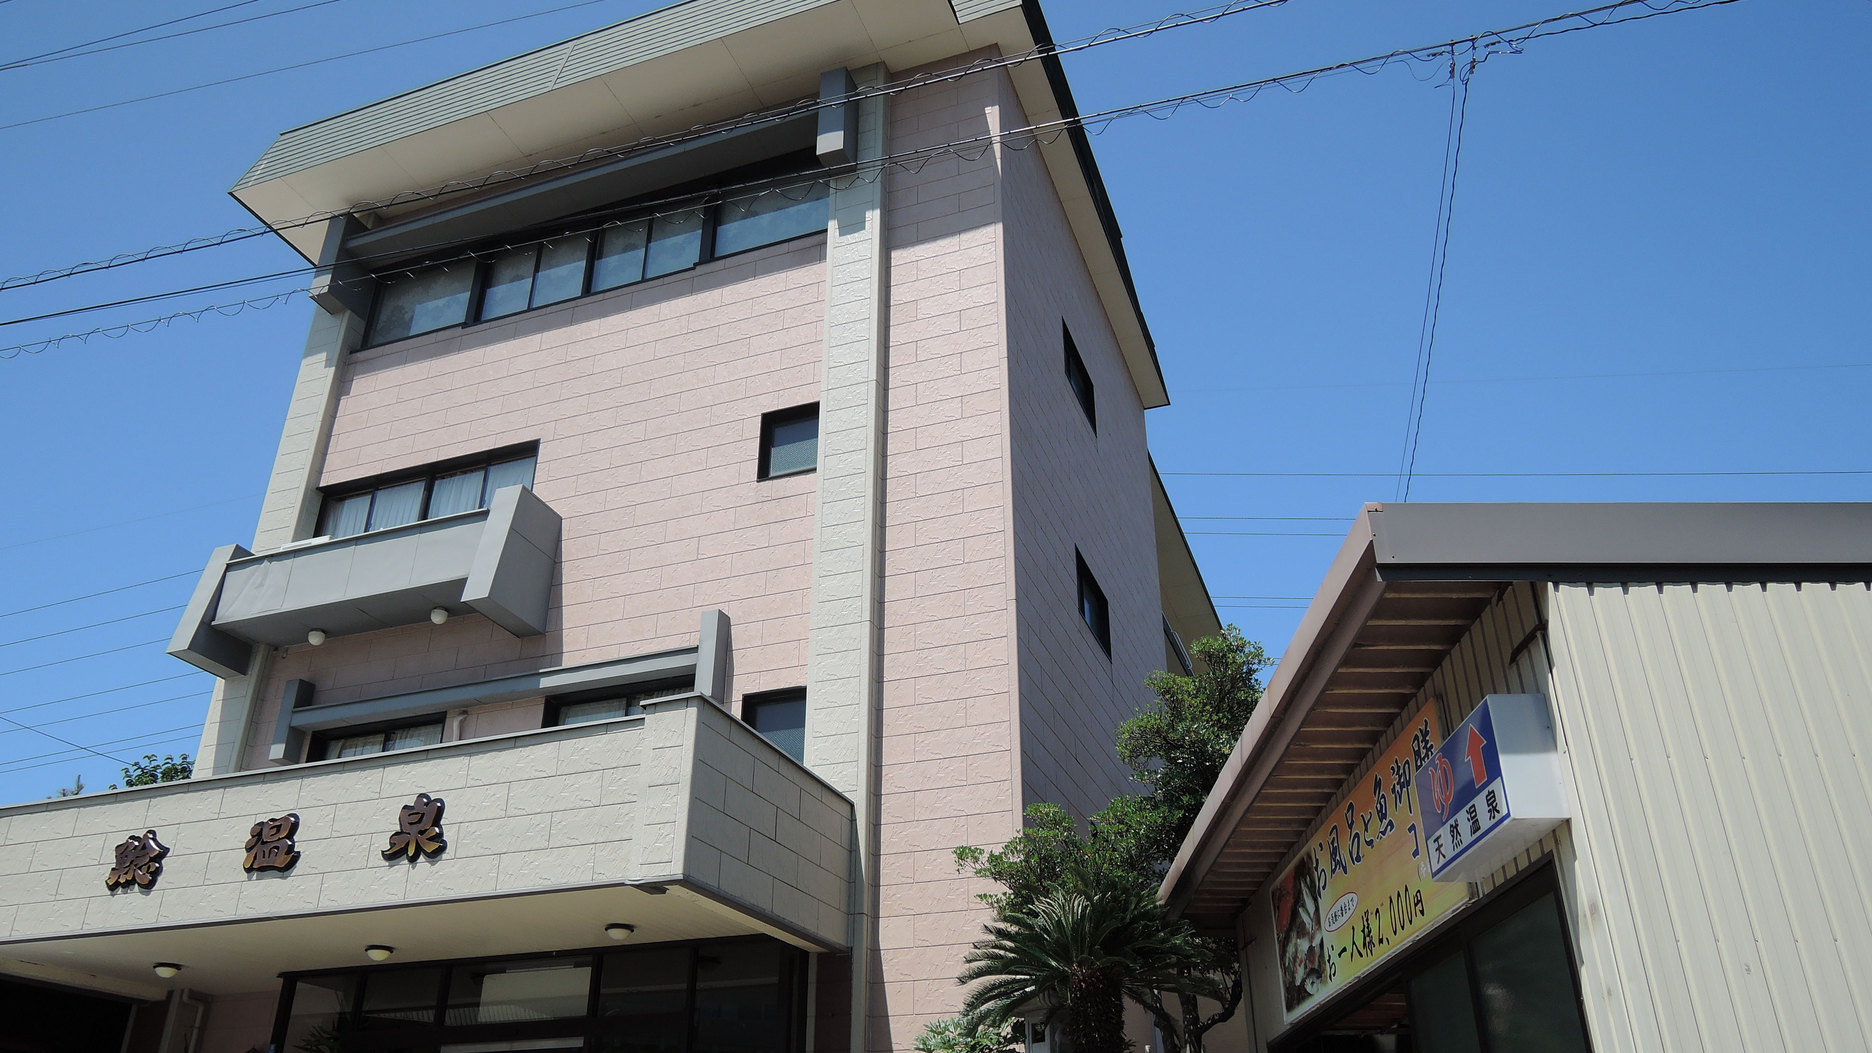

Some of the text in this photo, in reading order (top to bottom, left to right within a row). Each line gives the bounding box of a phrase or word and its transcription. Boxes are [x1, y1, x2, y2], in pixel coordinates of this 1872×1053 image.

[1428, 752, 1455, 822] ゆ
[105, 792, 448, 892] 鯰温泉
[1432, 789, 1501, 865] 天然温泉
